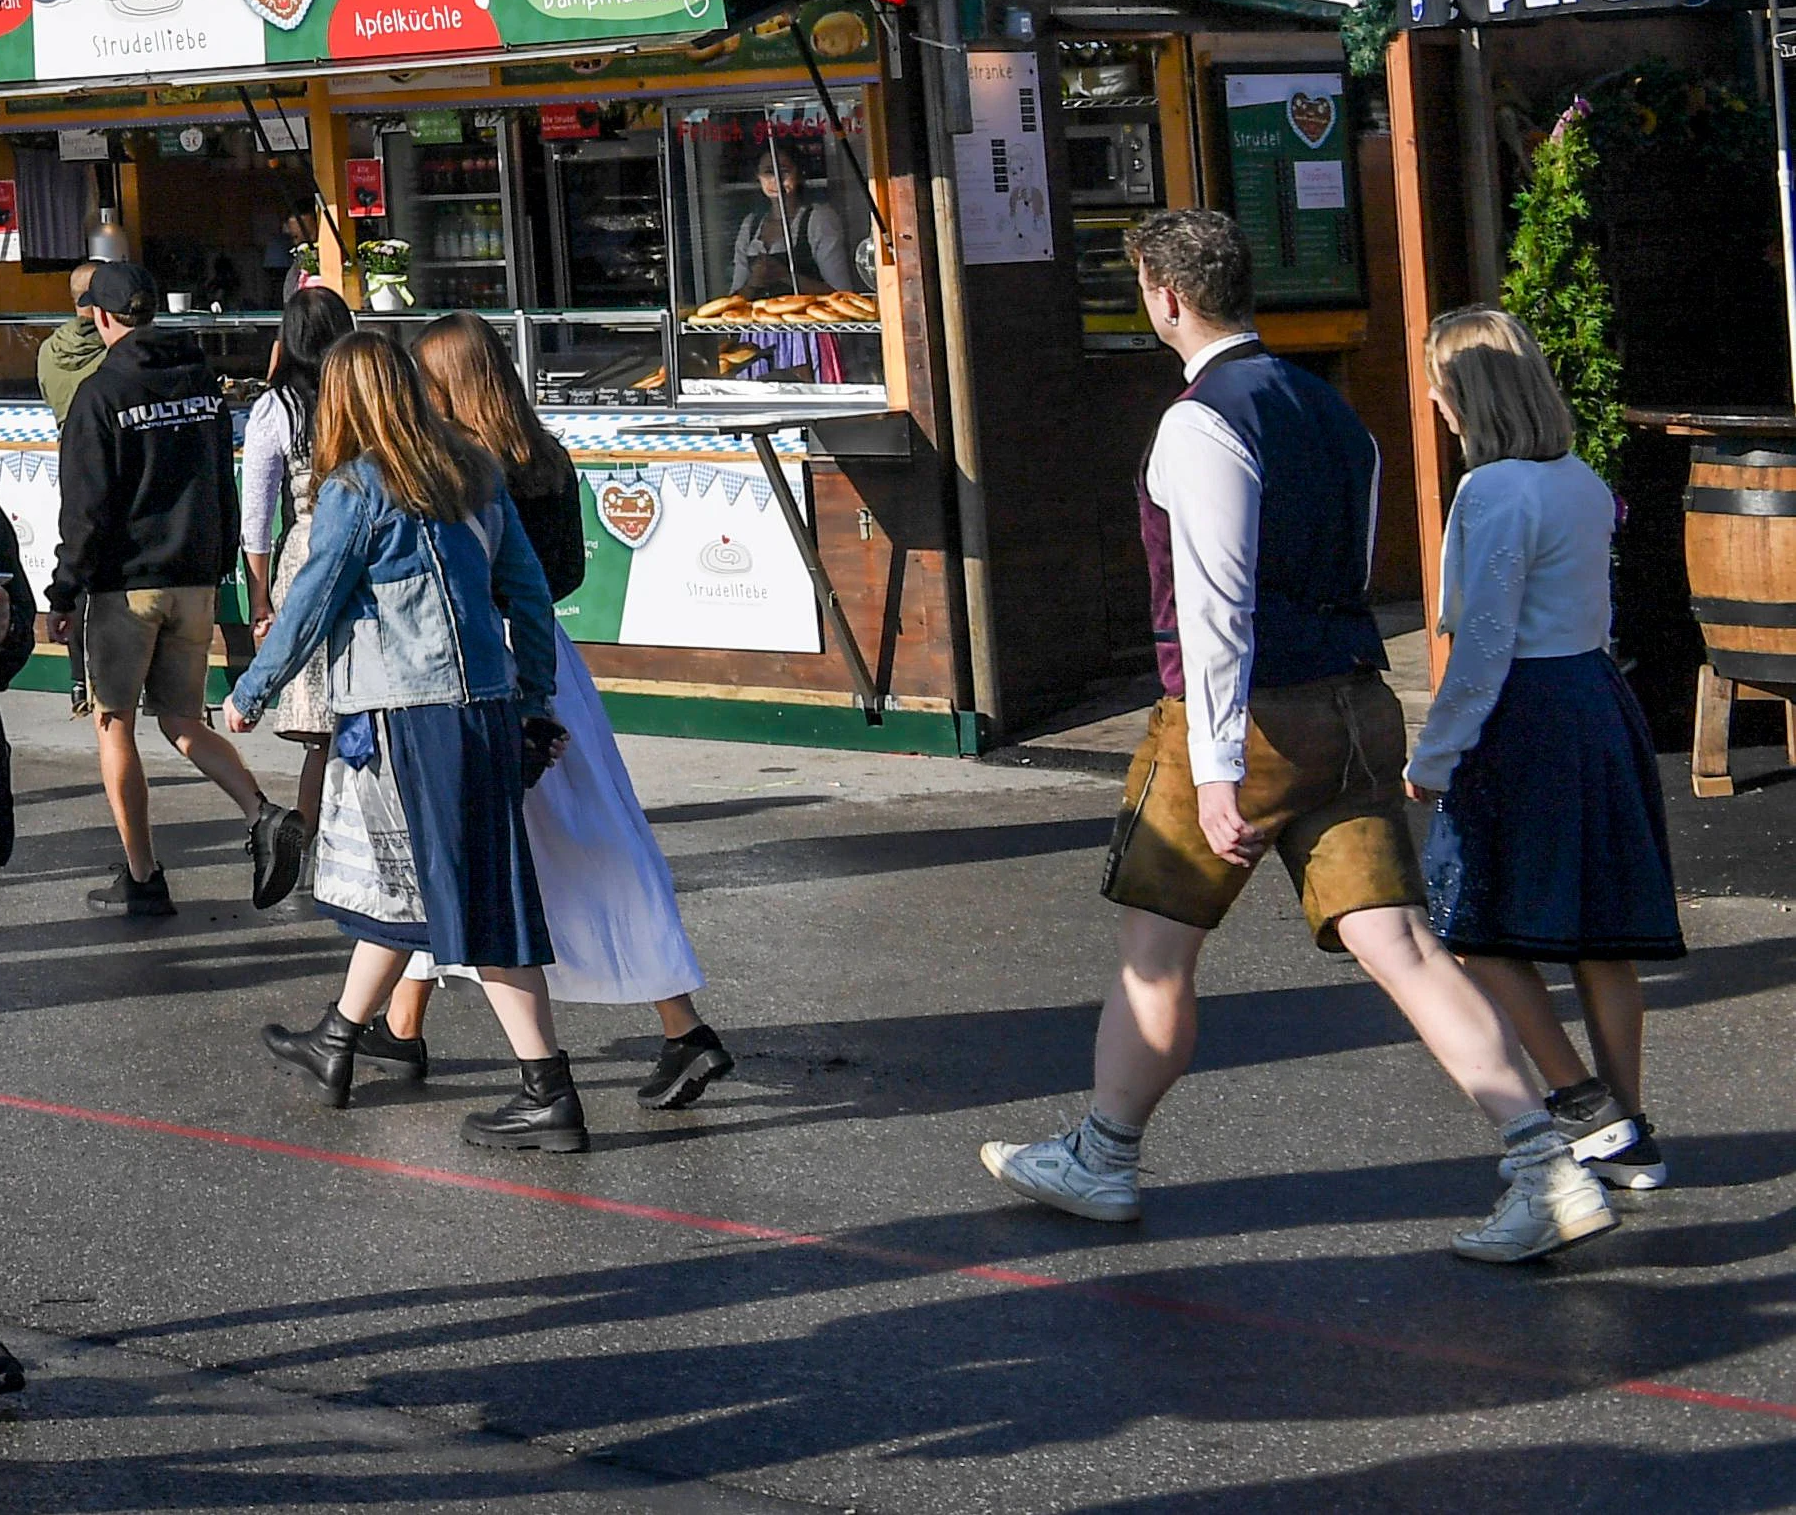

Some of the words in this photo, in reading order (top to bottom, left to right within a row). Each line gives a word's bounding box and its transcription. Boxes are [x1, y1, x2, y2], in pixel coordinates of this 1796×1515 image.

[354, 8, 463, 39] Apfelküchle
[92, 28, 207, 59] Strudelliebe
[968, 64, 1013, 81] etränke
[1233, 131, 1282, 148] Strudel
[117, 394, 224, 429] MULTIPLY
[685, 582, 769, 600] Strudelliebe
